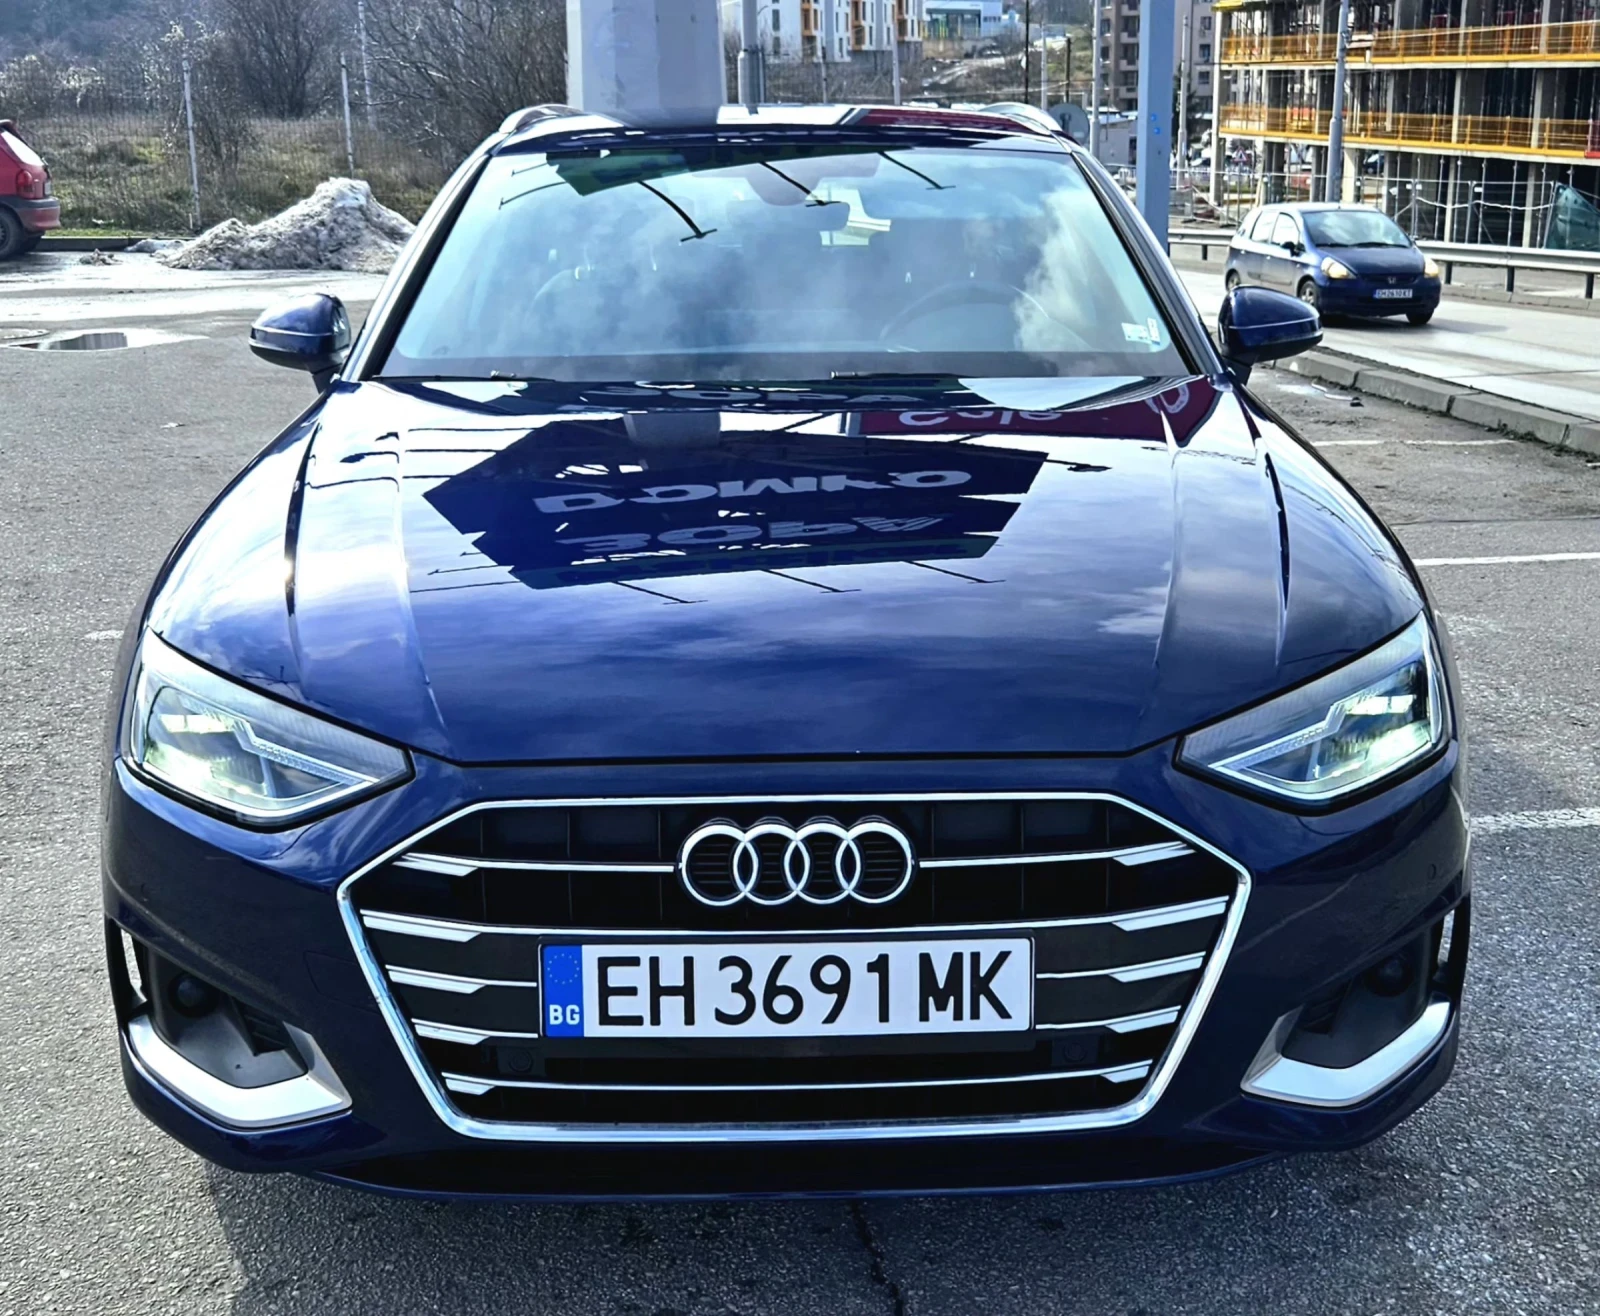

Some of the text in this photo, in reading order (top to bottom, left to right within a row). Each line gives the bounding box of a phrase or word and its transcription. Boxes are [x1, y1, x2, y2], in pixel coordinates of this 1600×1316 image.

[596, 950, 1013, 1027] EH 3691 MK
[549, 1004, 580, 1025] BG
